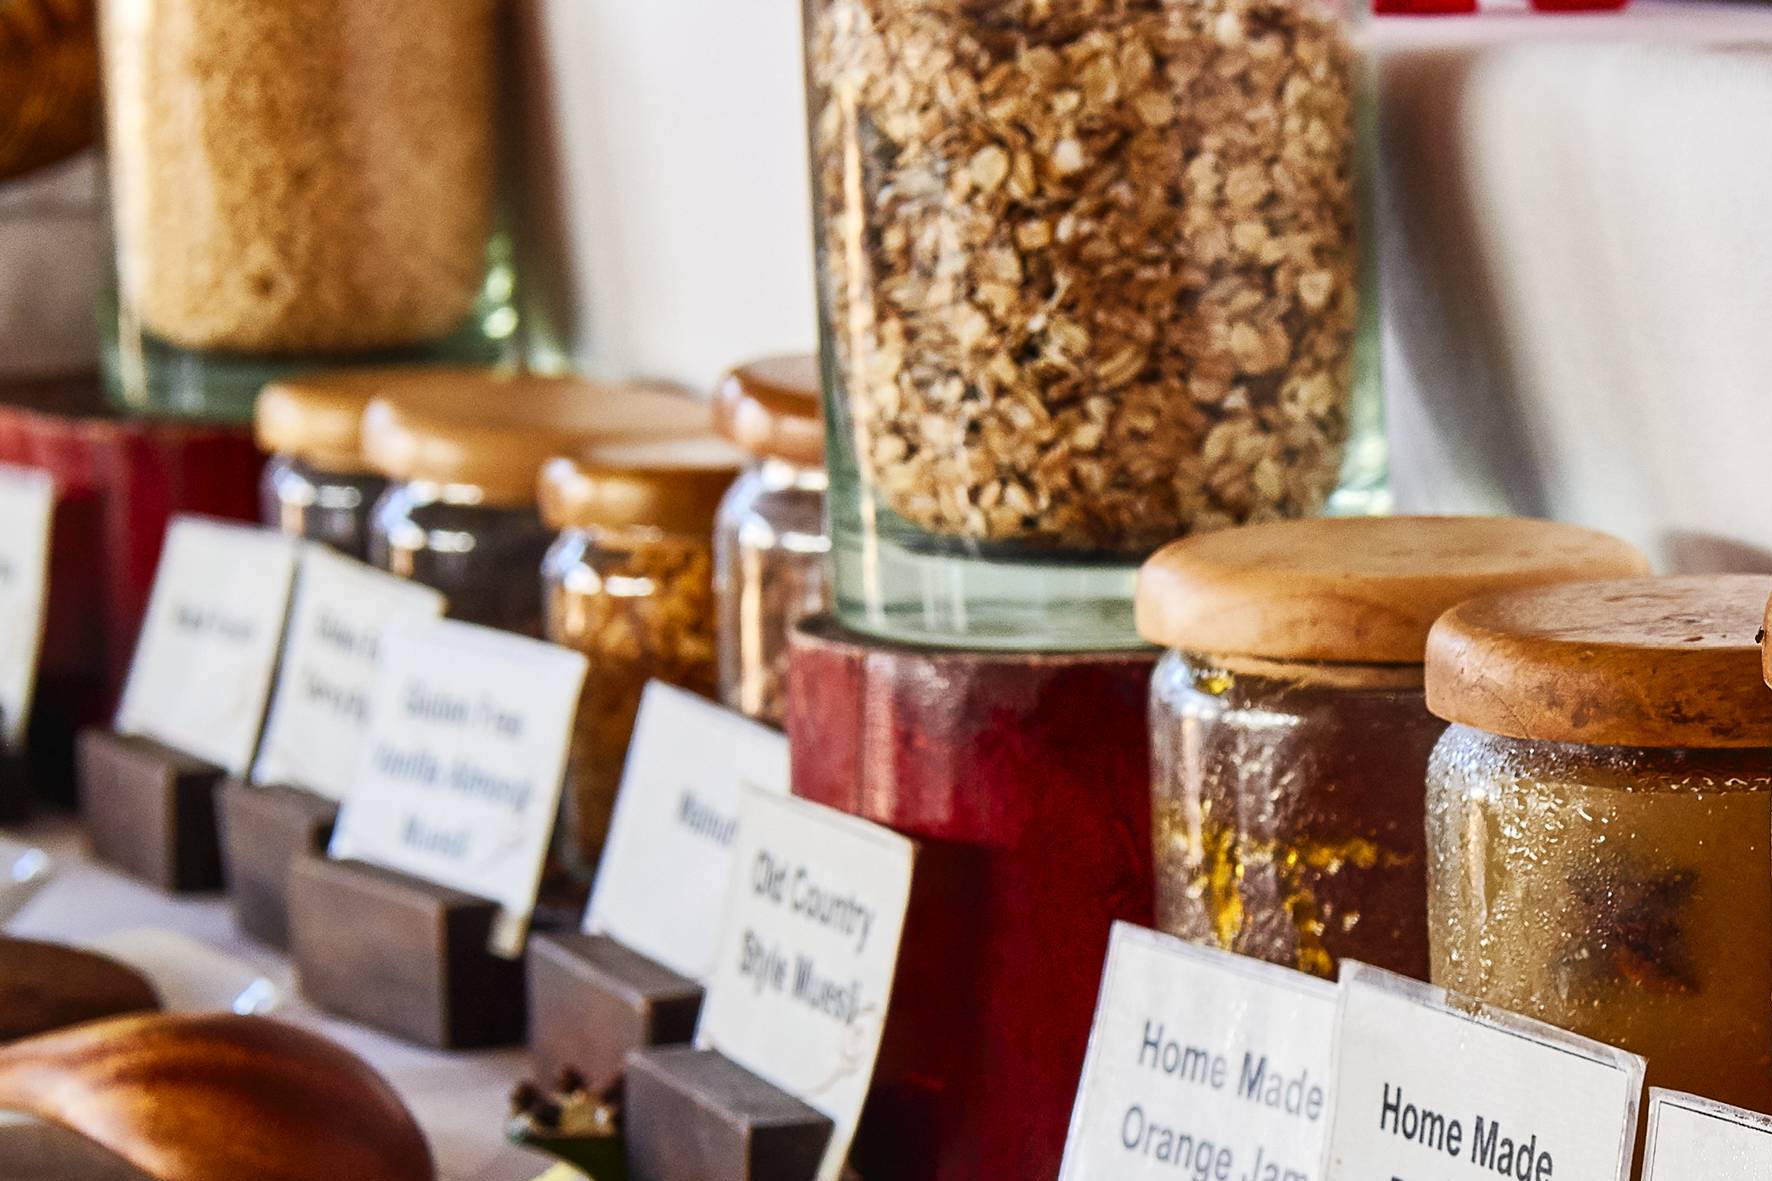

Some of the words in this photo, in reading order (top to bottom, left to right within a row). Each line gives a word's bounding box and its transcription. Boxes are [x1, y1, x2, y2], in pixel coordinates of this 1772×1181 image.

[753, 848, 788, 902] Old
[791, 867, 874, 953] Country
[740, 928, 788, 995] Style
[1138, 1019, 1227, 1089] Home
[1237, 1051, 1324, 1121] Made
[1380, 1082, 1463, 1157] Home
